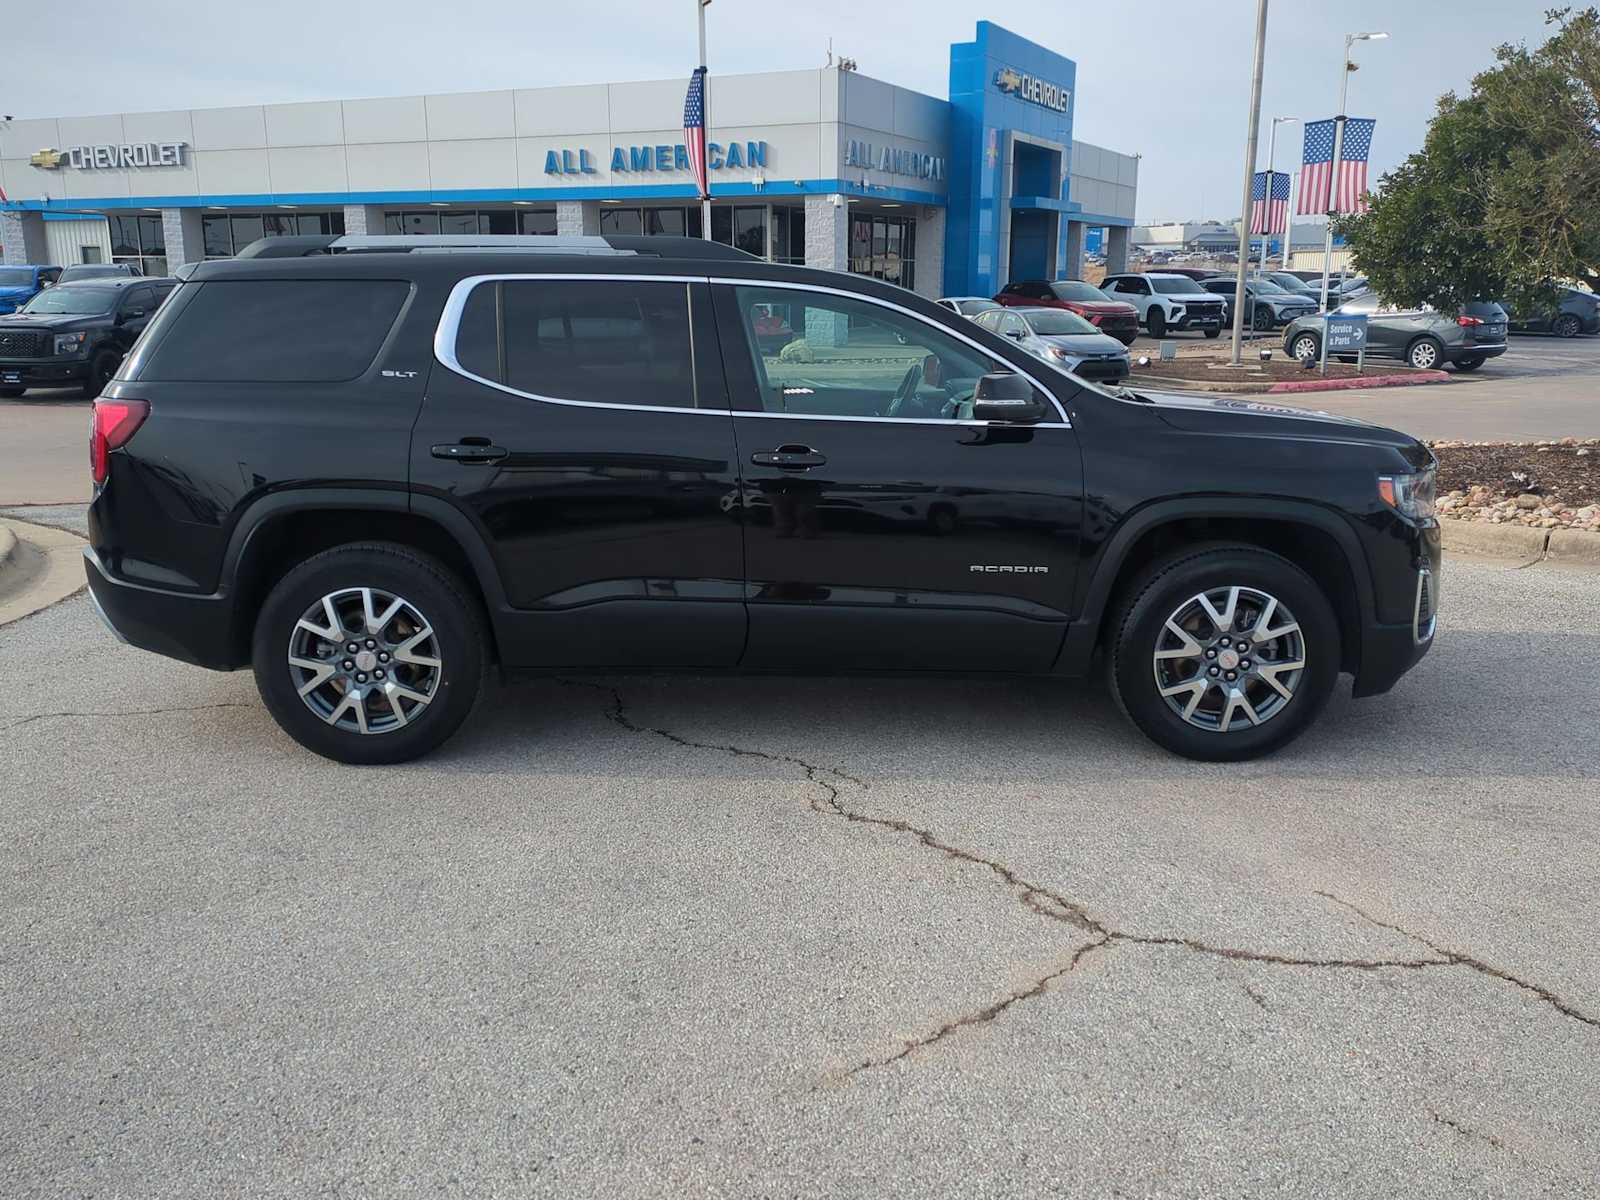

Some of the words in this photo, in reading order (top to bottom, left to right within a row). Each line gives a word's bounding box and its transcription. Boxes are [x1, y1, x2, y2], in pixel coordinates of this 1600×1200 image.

[1021, 73, 1071, 113] CHEVROLET
[68, 142, 187, 169] CHEVROLET
[543, 148, 596, 175] ALL
[610, 141, 768, 172] AMERCAN
[844, 139, 875, 169] ALL
[1330, 324, 1353, 334] Service
[1335, 336, 1351, 345] Parts
[381, 370, 418, 378] SLT
[970, 565, 1049, 573] ACADIA
